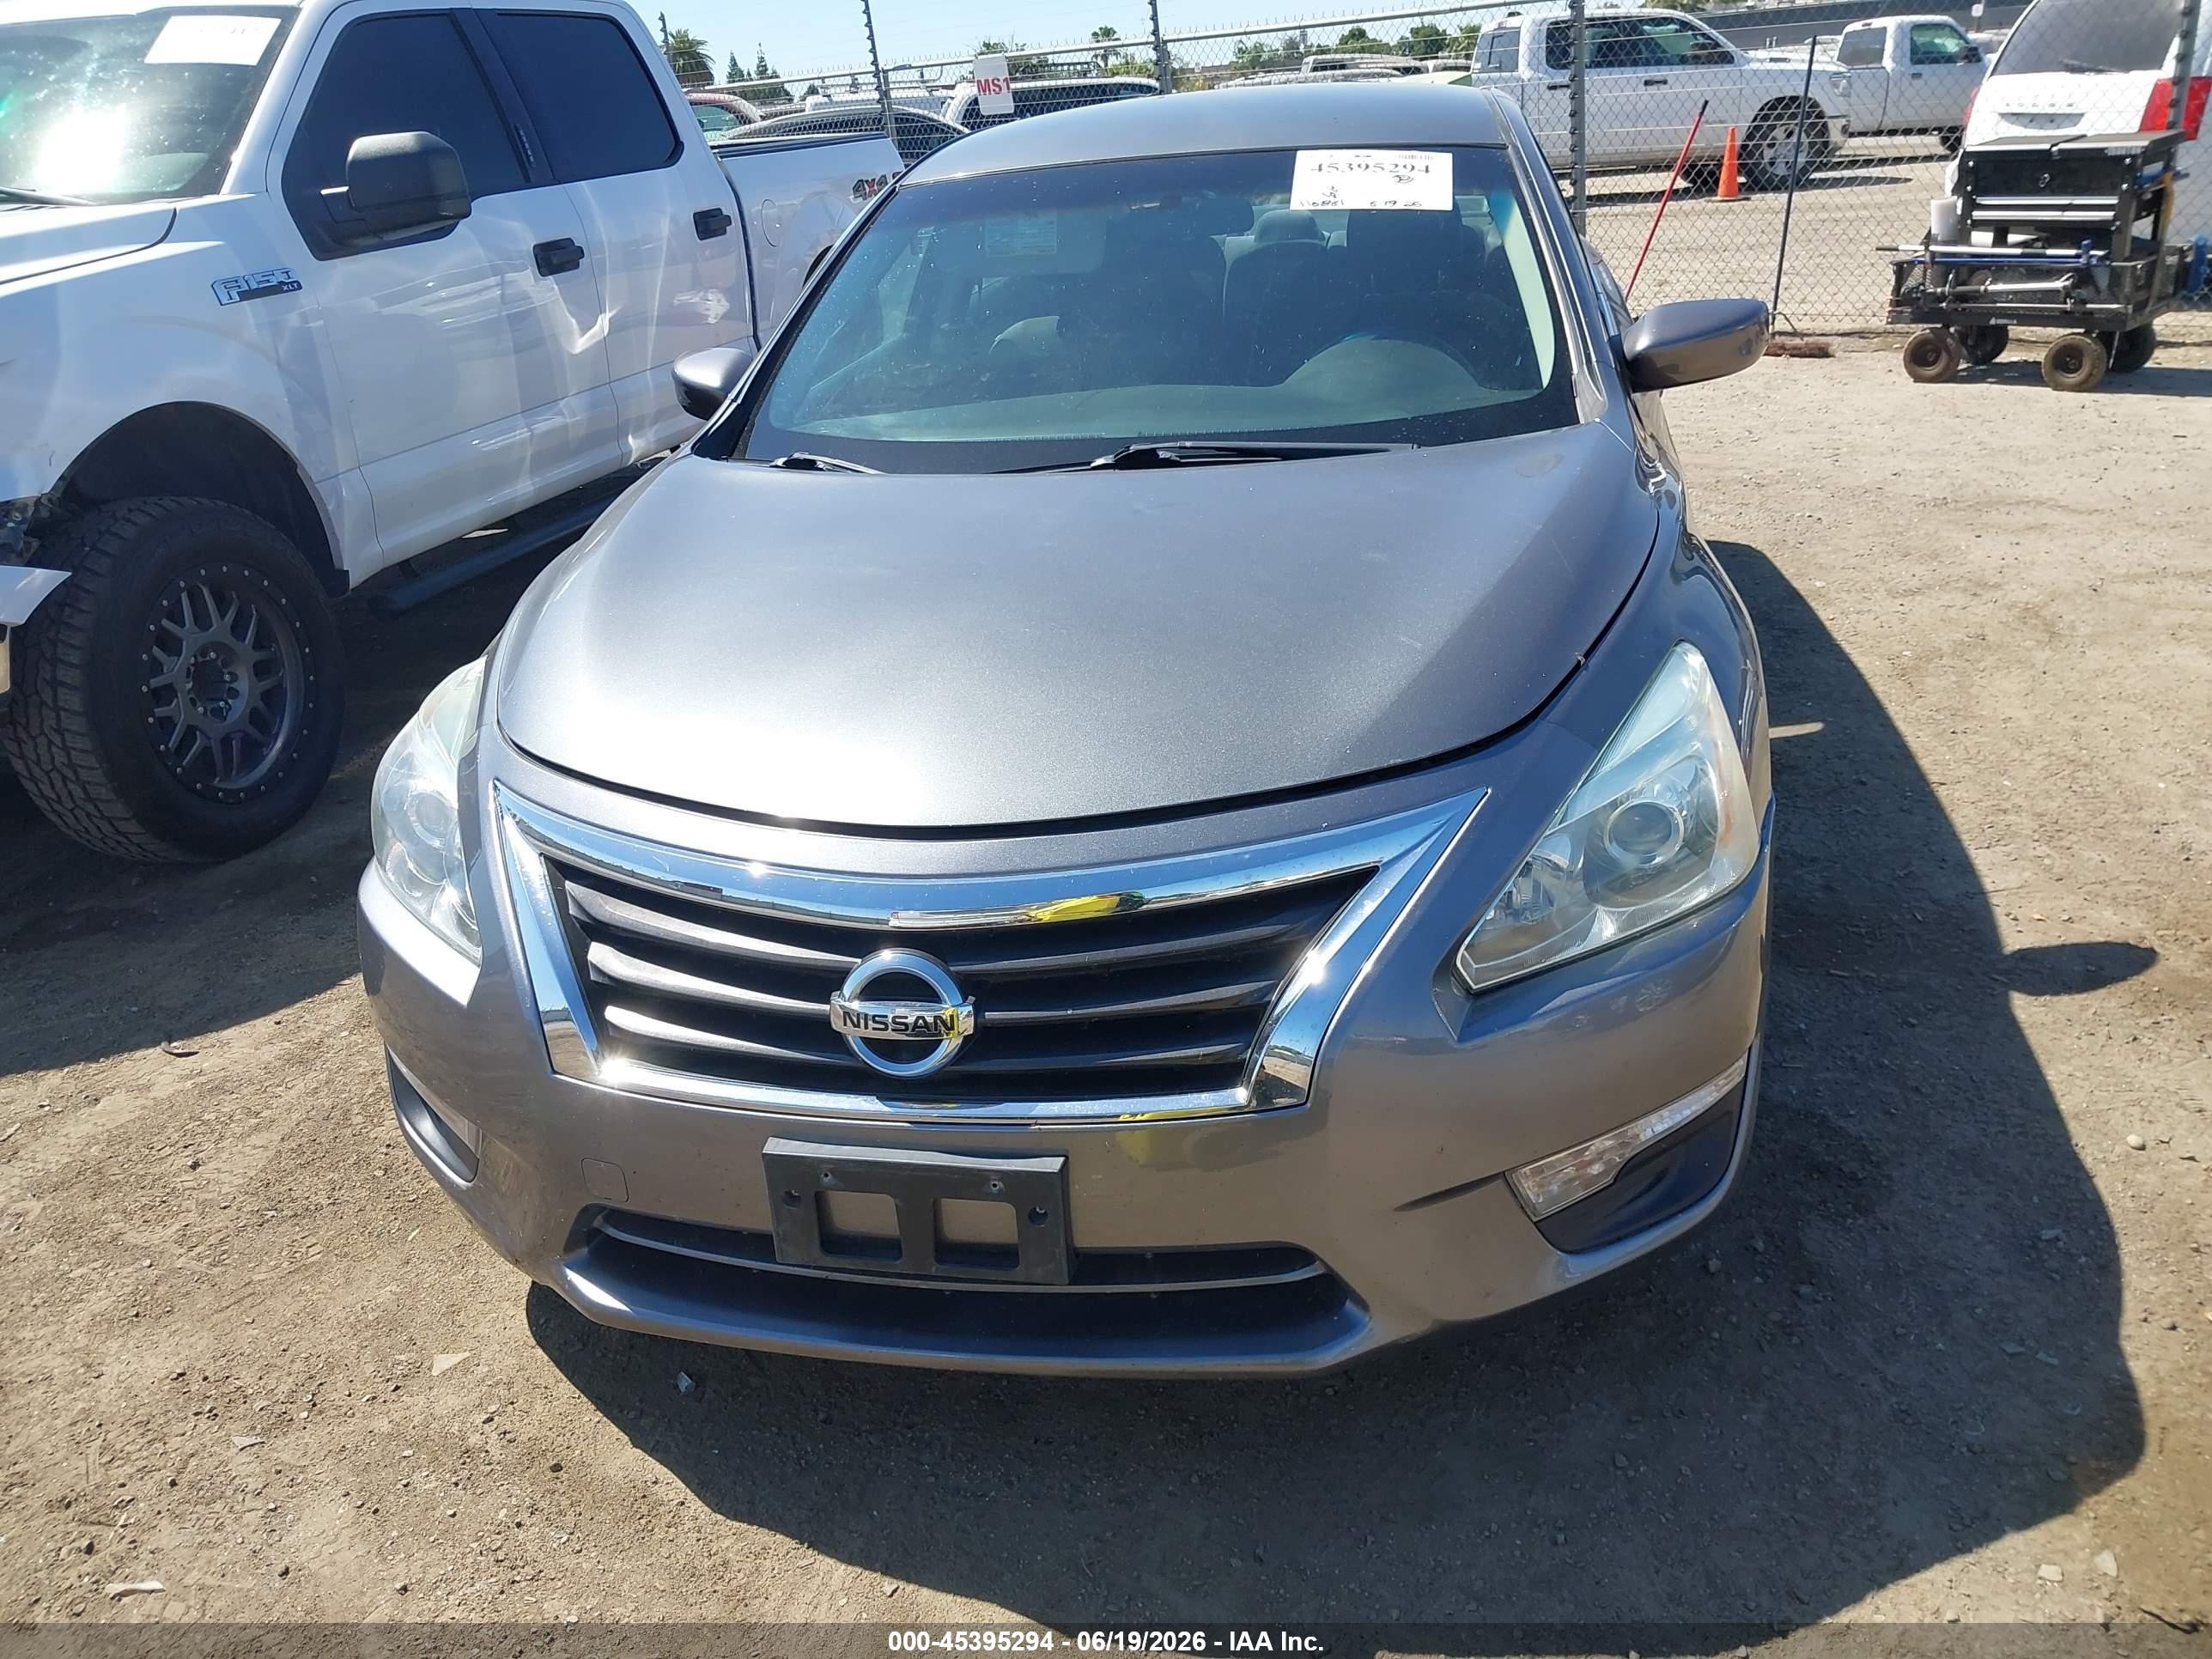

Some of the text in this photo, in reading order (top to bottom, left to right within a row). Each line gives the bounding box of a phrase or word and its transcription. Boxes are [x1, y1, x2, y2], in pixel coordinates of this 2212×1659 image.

[976, 77, 1011, 96] MS1
[1310, 162, 1432, 173] 45395294
[282, 283, 299, 291] XLT
[842, 1011, 955, 1032] NISSAN
